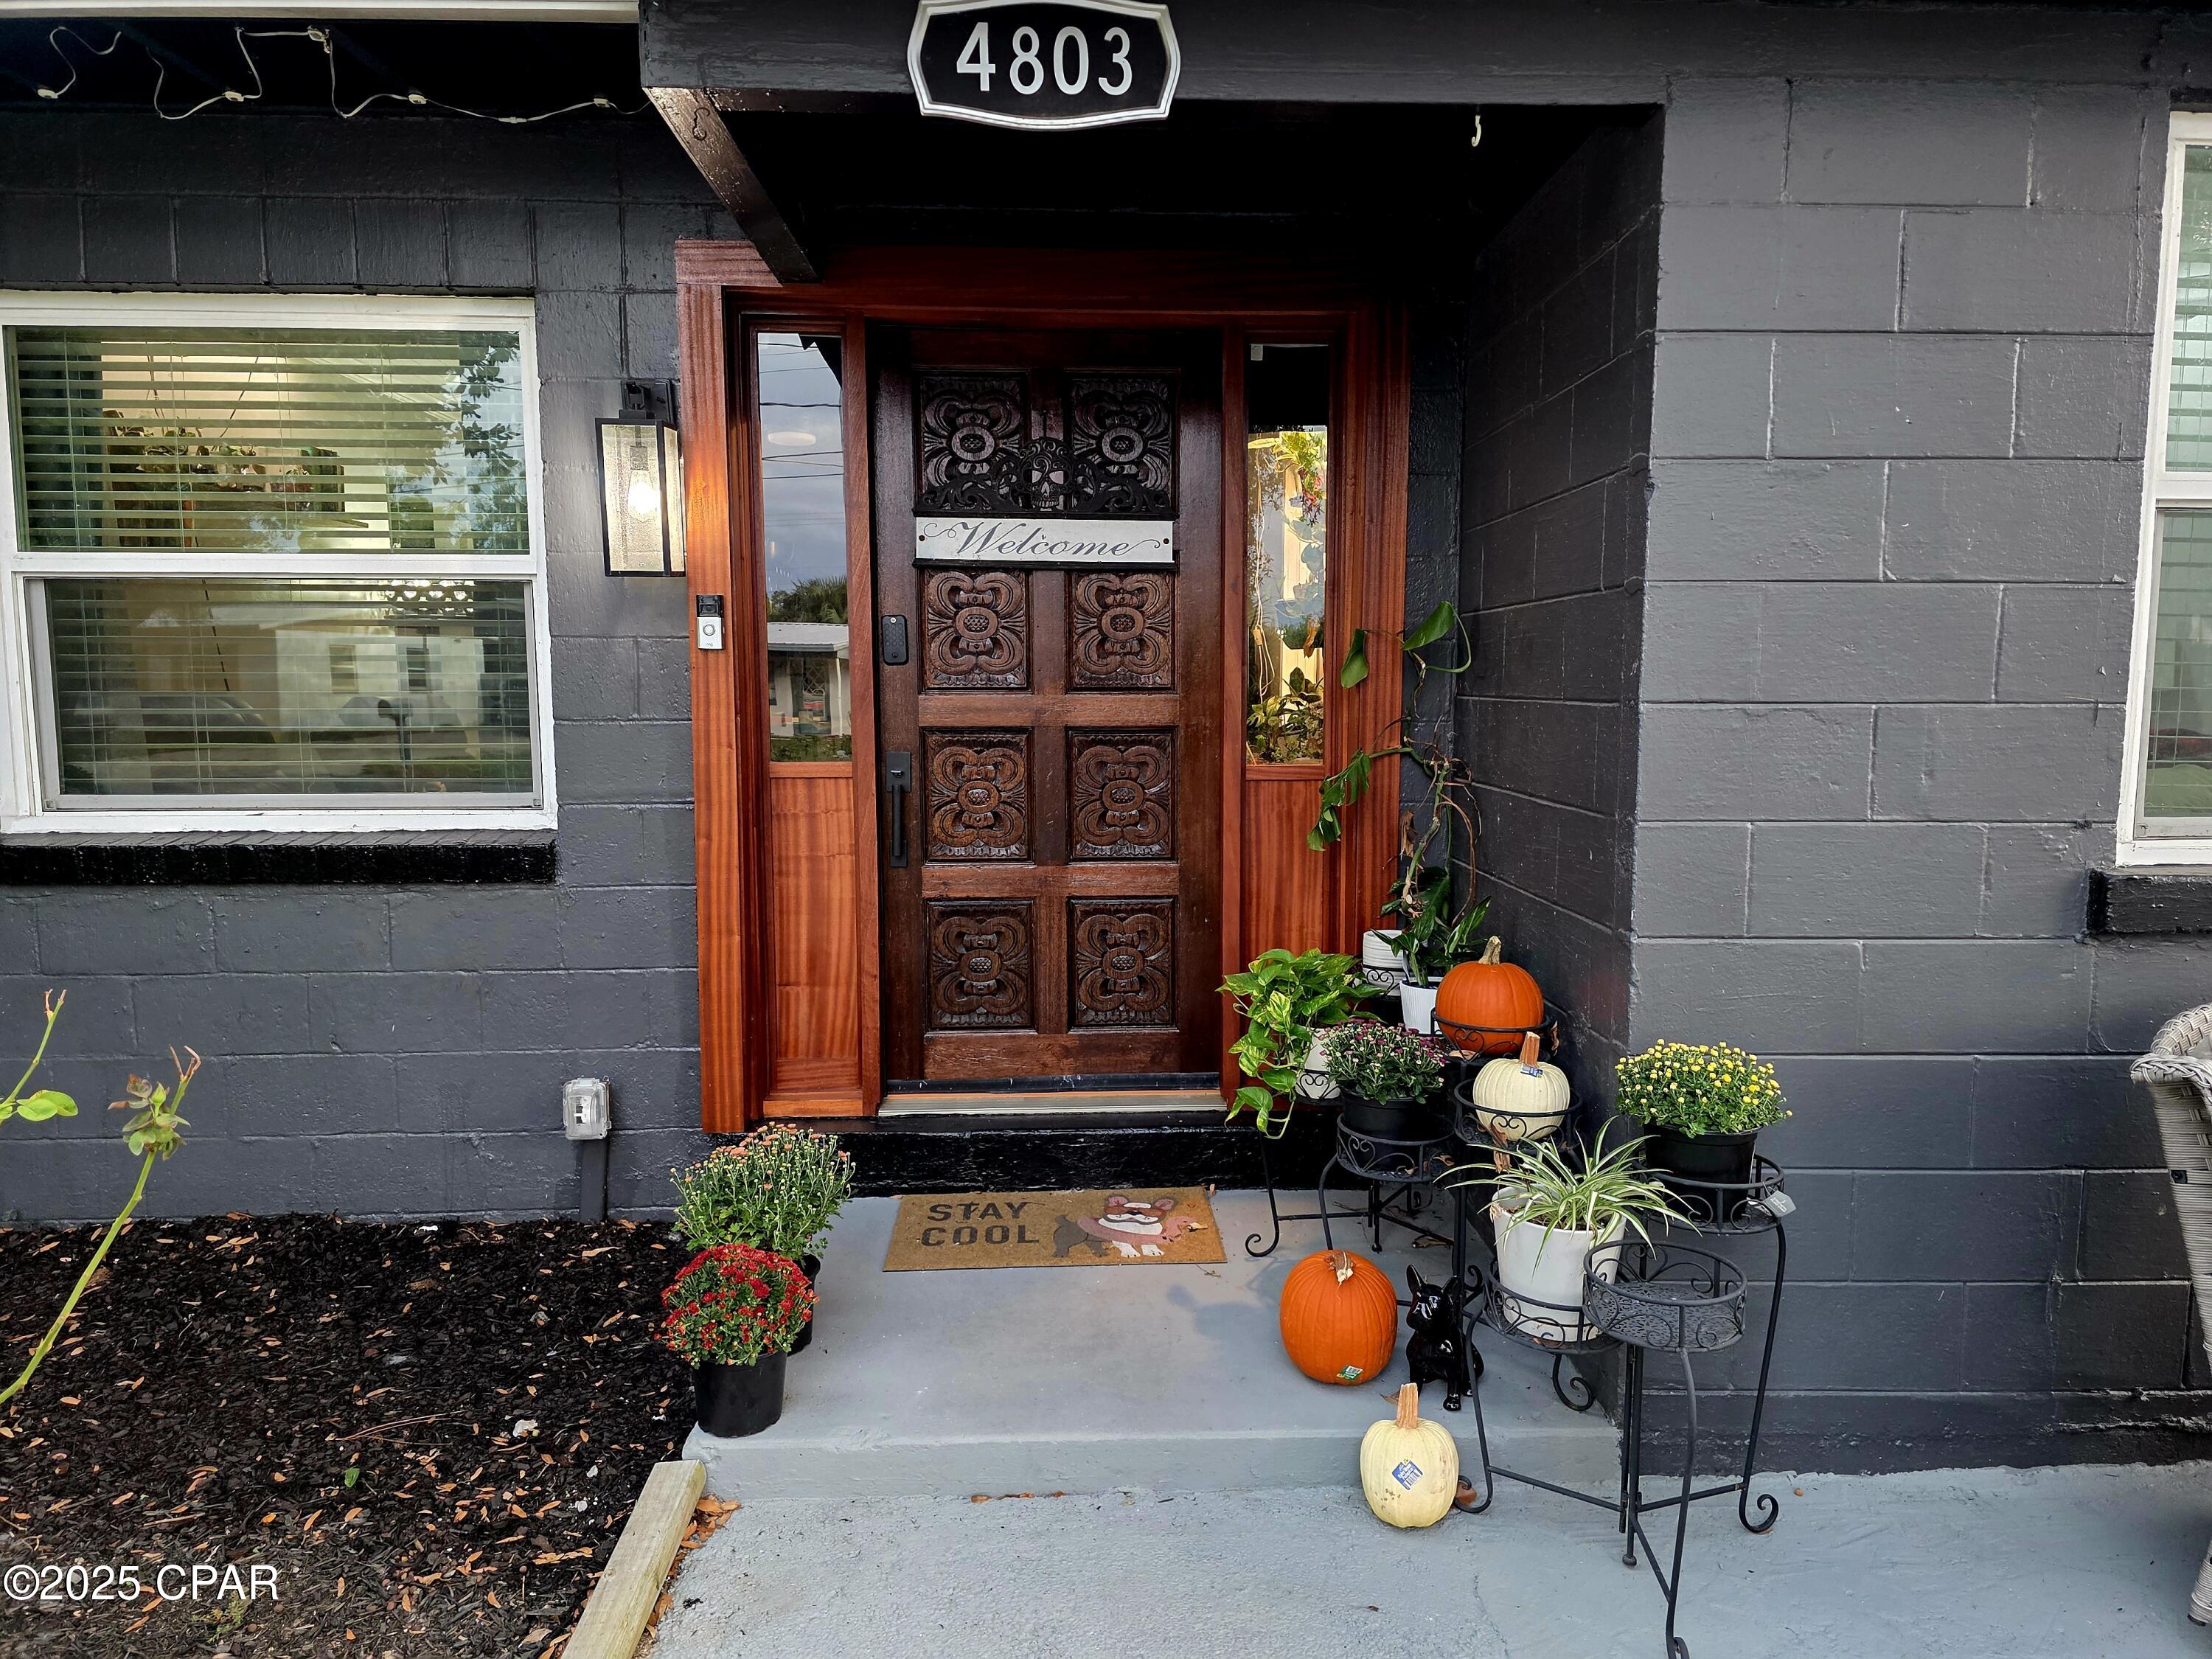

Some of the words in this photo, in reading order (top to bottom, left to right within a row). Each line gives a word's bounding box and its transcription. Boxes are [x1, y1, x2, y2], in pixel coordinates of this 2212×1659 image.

[956, 21, 1133, 96] 4803
[923, 521, 1161, 557] Welcome
[927, 1202, 1027, 1221] STAY
[921, 1224, 1040, 1247] COOL
